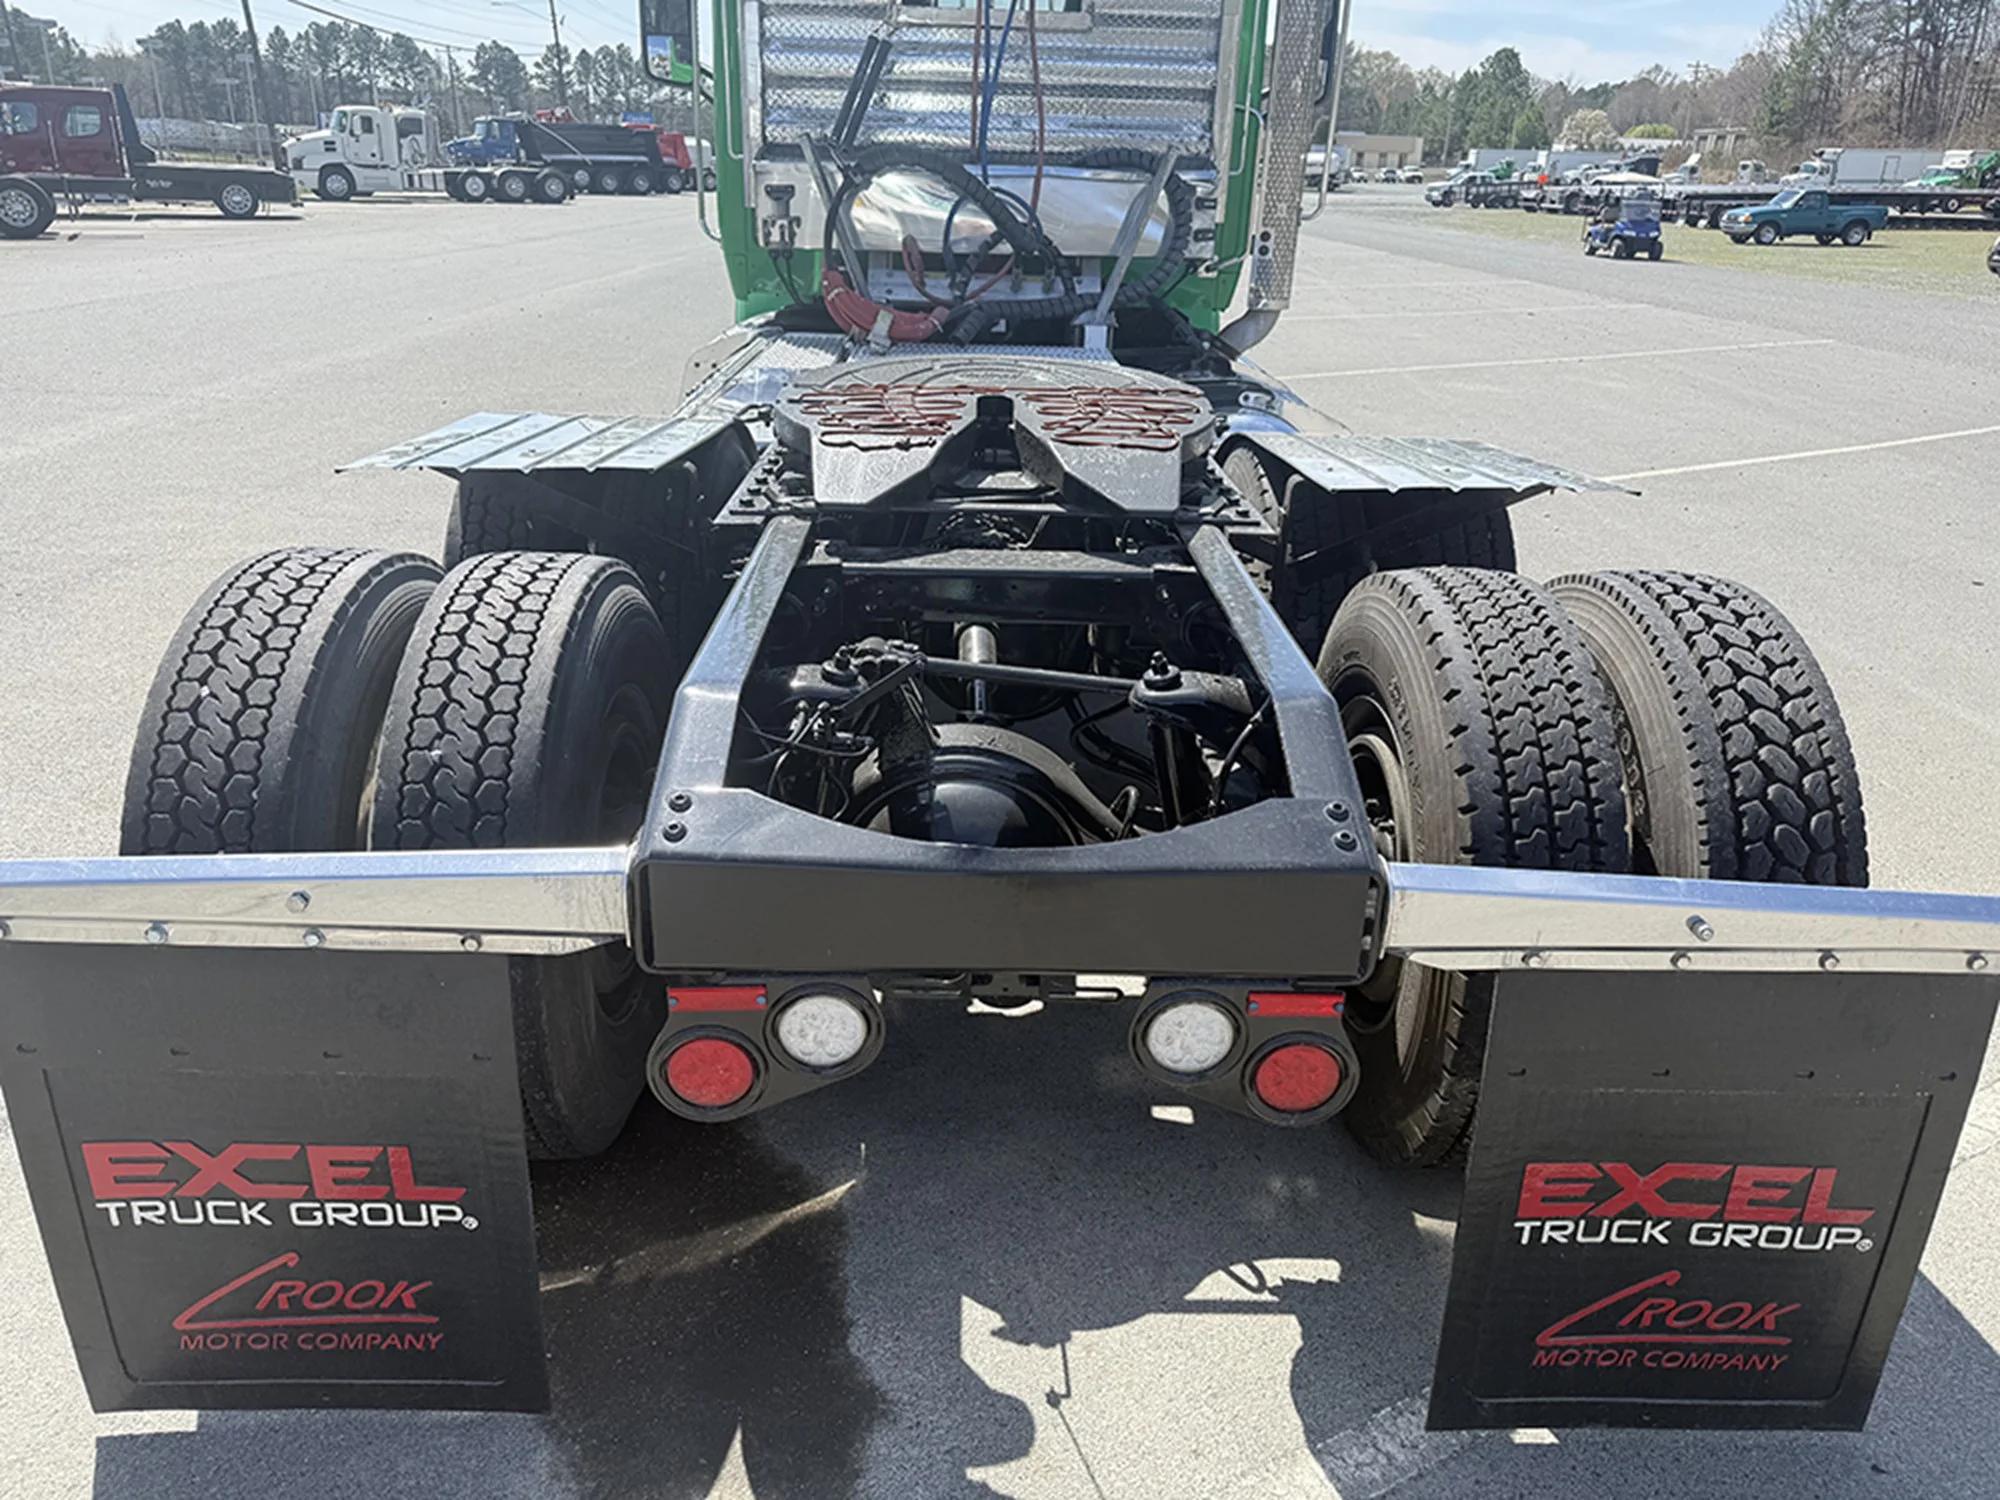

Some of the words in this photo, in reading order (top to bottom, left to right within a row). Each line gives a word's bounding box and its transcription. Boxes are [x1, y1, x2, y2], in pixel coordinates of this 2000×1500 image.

[82, 1141, 467, 1201] EXCEL
[1517, 1162, 1876, 1224] EXCEL
[95, 1200, 273, 1228] TRUCK
[1513, 1219, 1671, 1246] TRUCK
[179, 1332, 289, 1350] MOTOR
[296, 1332, 445, 1351] COMPANY
[1531, 1349, 1638, 1368] MOTOR
[1642, 1351, 1789, 1372] COMPANY
